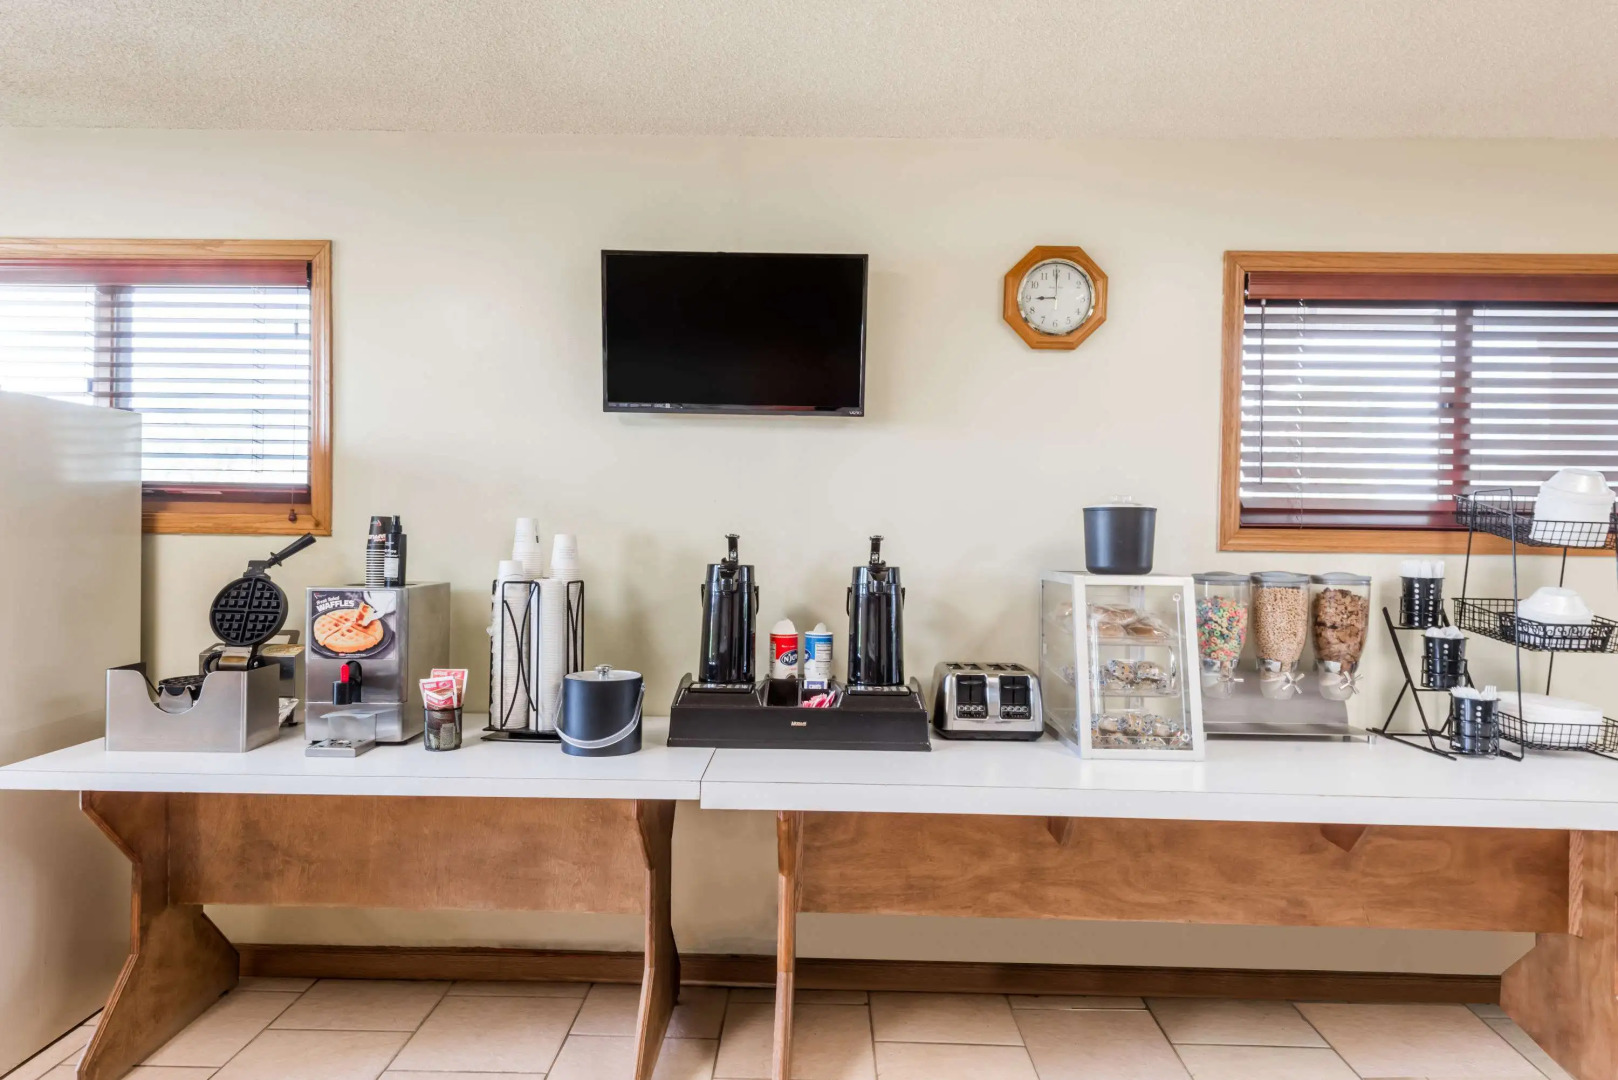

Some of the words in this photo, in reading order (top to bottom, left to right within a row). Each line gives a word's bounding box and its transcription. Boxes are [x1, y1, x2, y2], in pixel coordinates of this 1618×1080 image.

[1040, 272, 1048, 281] 11
[1052, 269, 1061, 277] 12
[1067, 272, 1071, 281] 1
[1030, 280, 1039, 289] 10
[1076, 281, 1082, 289] 2
[1026, 294, 1031, 302] 9
[1029, 306, 1036, 315] 8
[1075, 307, 1081, 316] 4
[1040, 316, 1046, 325] 7
[1052, 320, 1058, 328] 6
[1066, 316, 1072, 325] 5
[315, 599, 355, 613] WAFFLES
